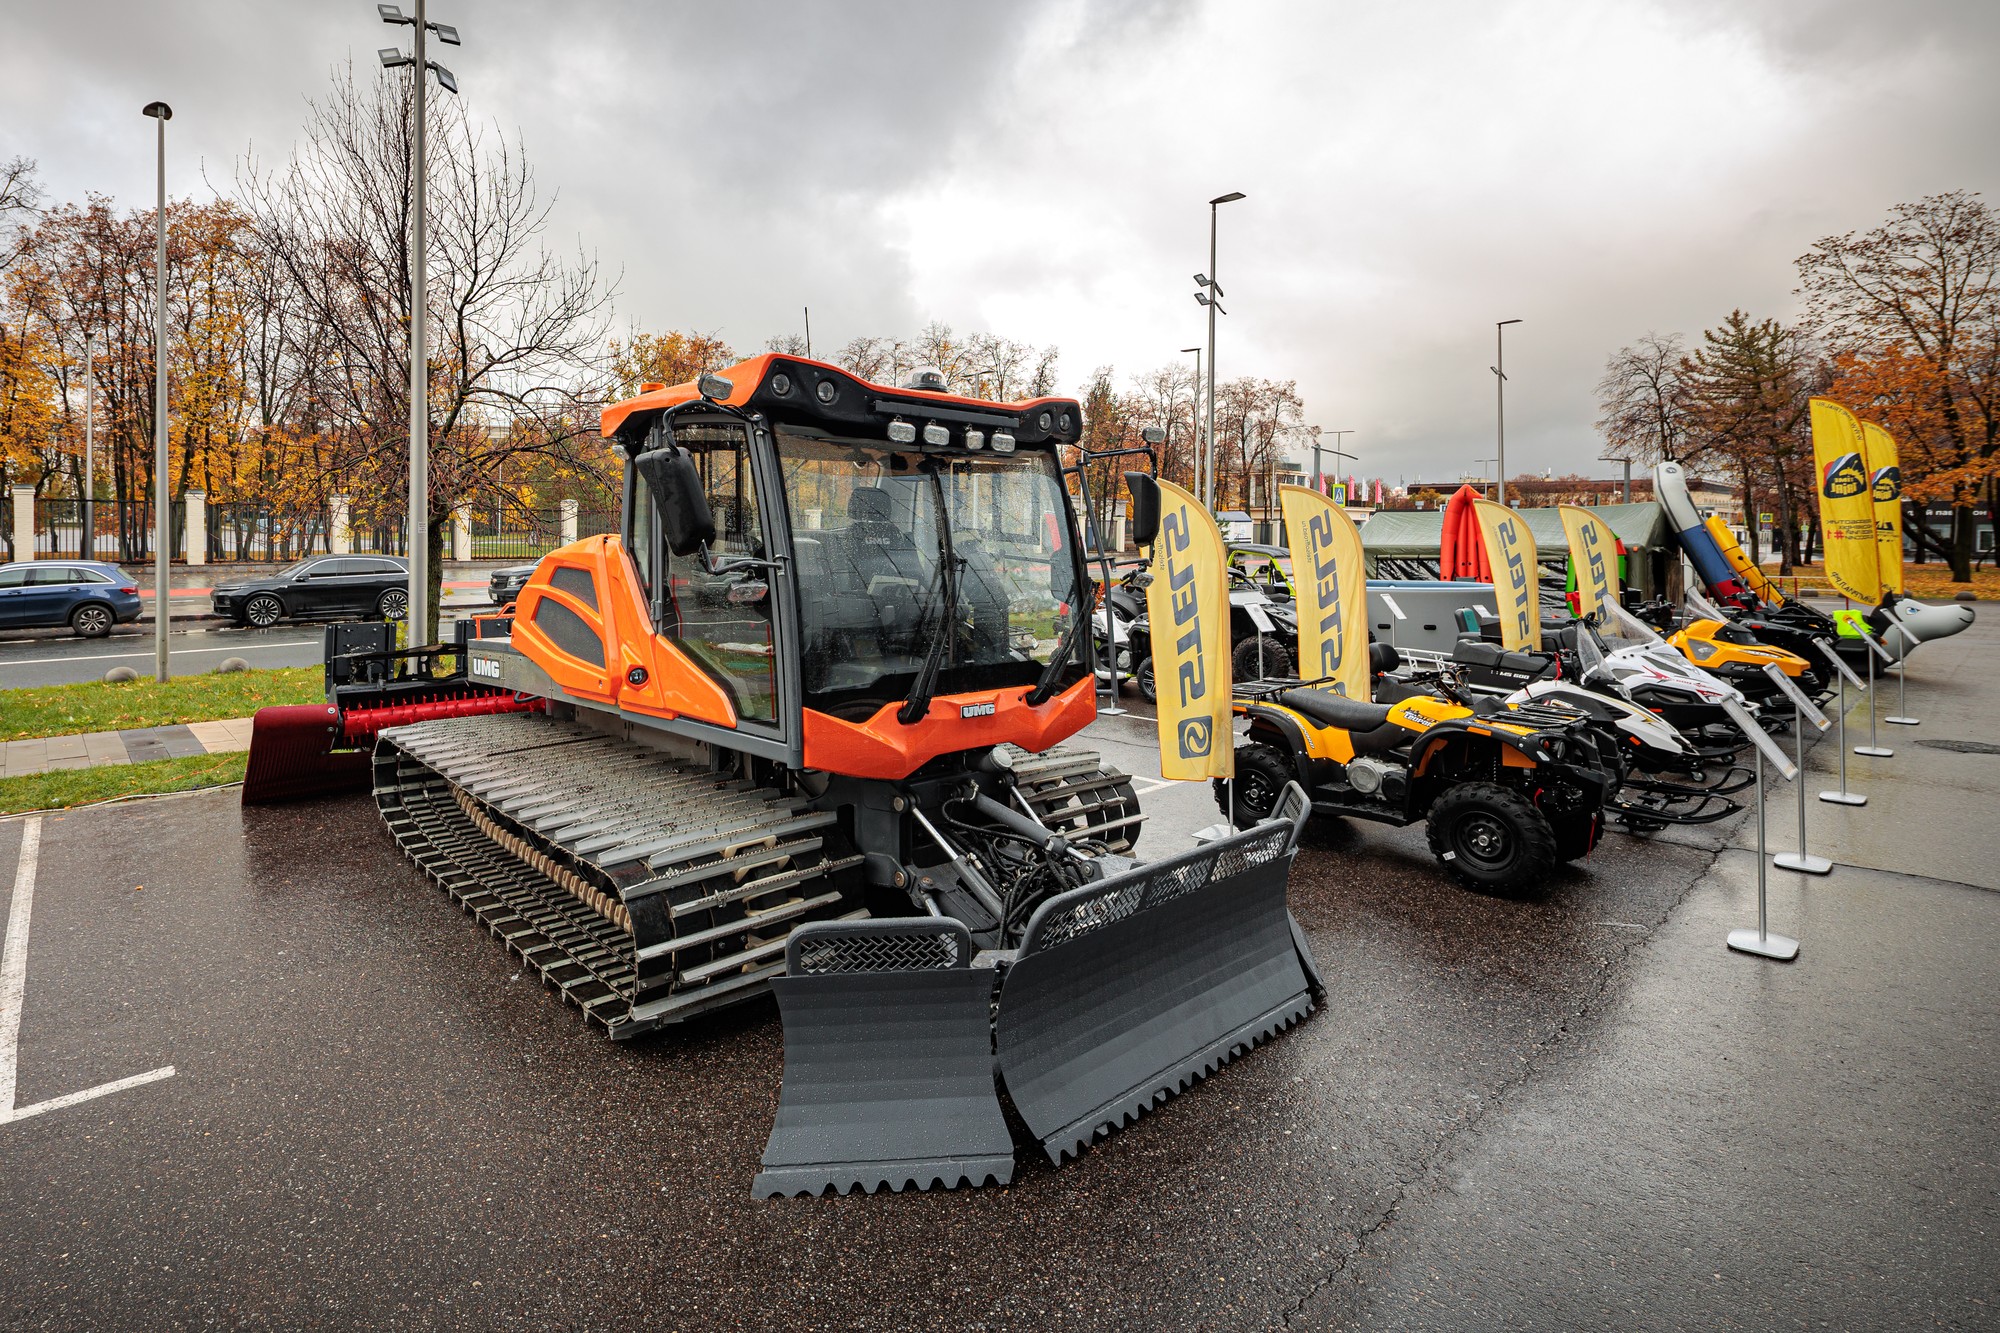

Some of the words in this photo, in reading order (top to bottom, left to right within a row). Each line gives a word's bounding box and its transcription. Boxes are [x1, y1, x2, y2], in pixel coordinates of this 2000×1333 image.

[865, 537, 891, 545] UMG
[473, 658, 500, 678] UMG
[963, 703, 996, 718] UMG
